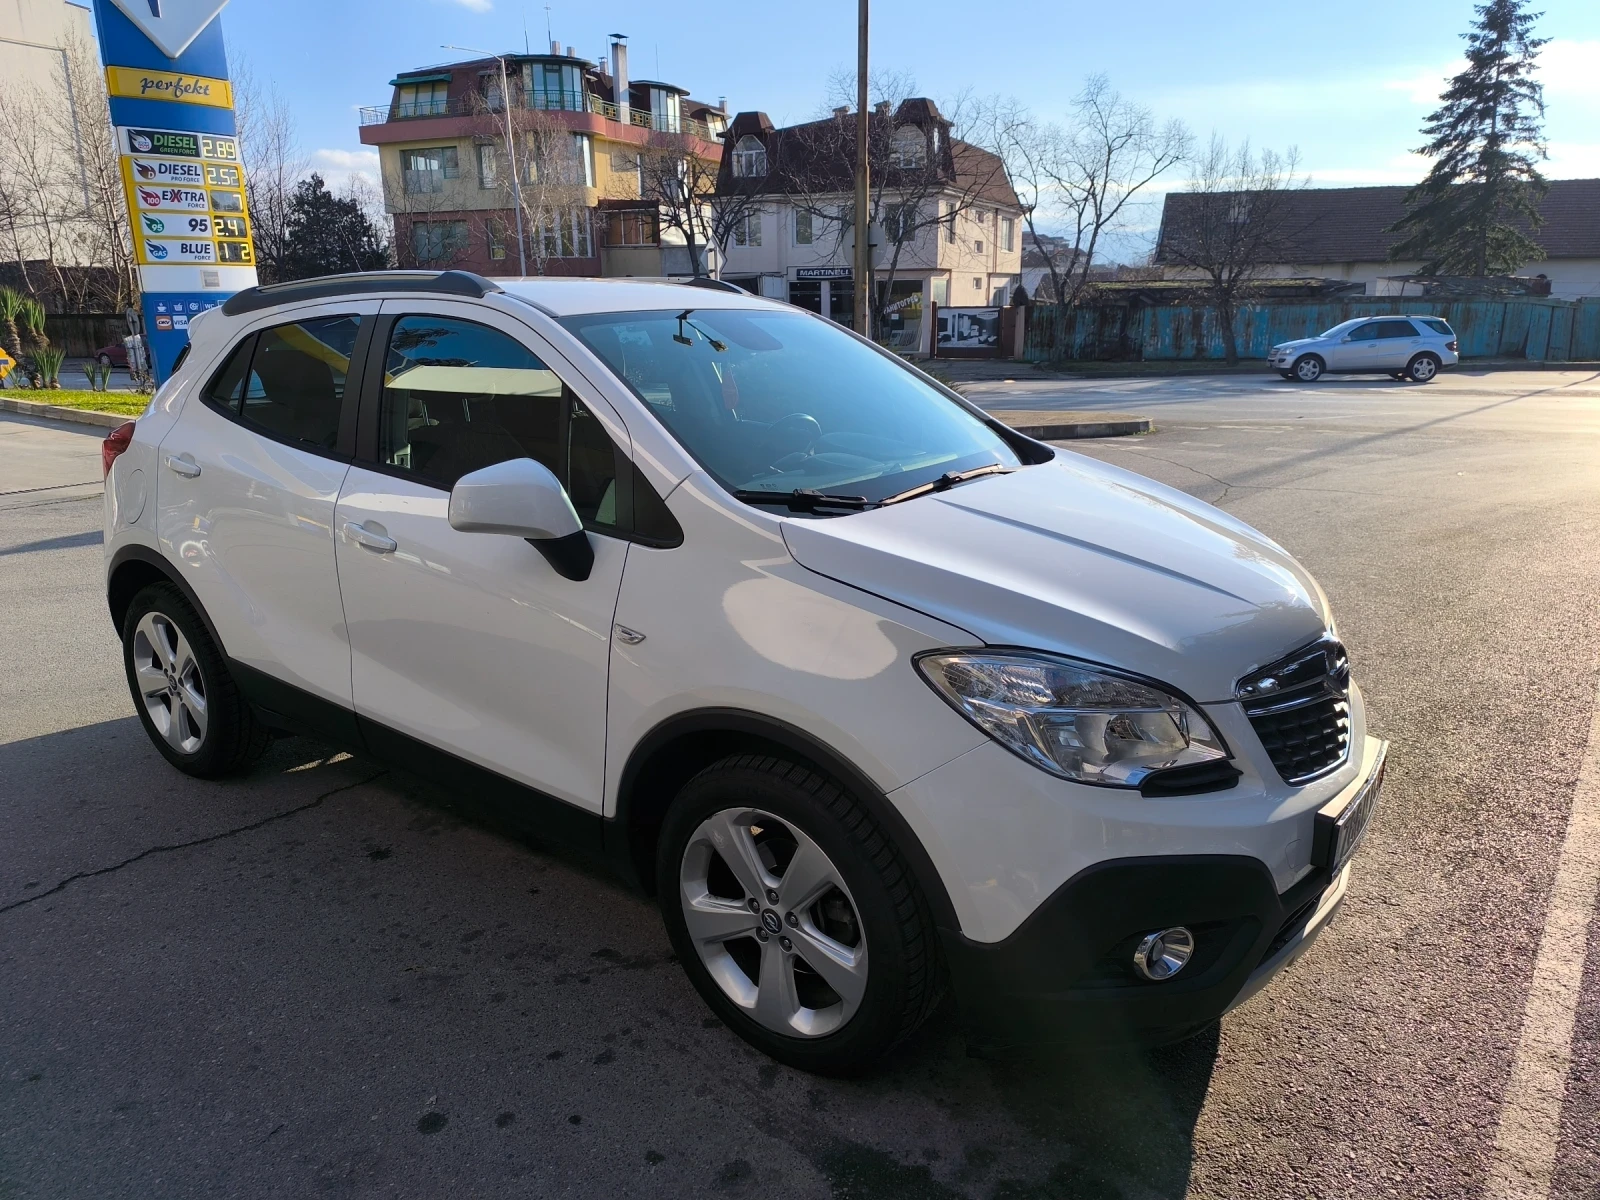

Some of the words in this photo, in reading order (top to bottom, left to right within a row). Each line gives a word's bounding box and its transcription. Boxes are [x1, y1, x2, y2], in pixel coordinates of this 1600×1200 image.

[140, 76, 210, 98] perfekt
[153, 134, 197, 149] DIESEL
[160, 146, 178, 154] GREEN
[178, 147, 196, 155] FORCE
[203, 139, 236, 159] 2.89
[158, 163, 201, 177] DIESEL
[207, 167, 239, 187] 2.52
[146, 197, 161, 205] 100
[162, 188, 205, 203] EXTRA
[151, 223, 163, 231] 95
[188, 218, 208, 232] 95
[180, 243, 211, 254] BLUE
